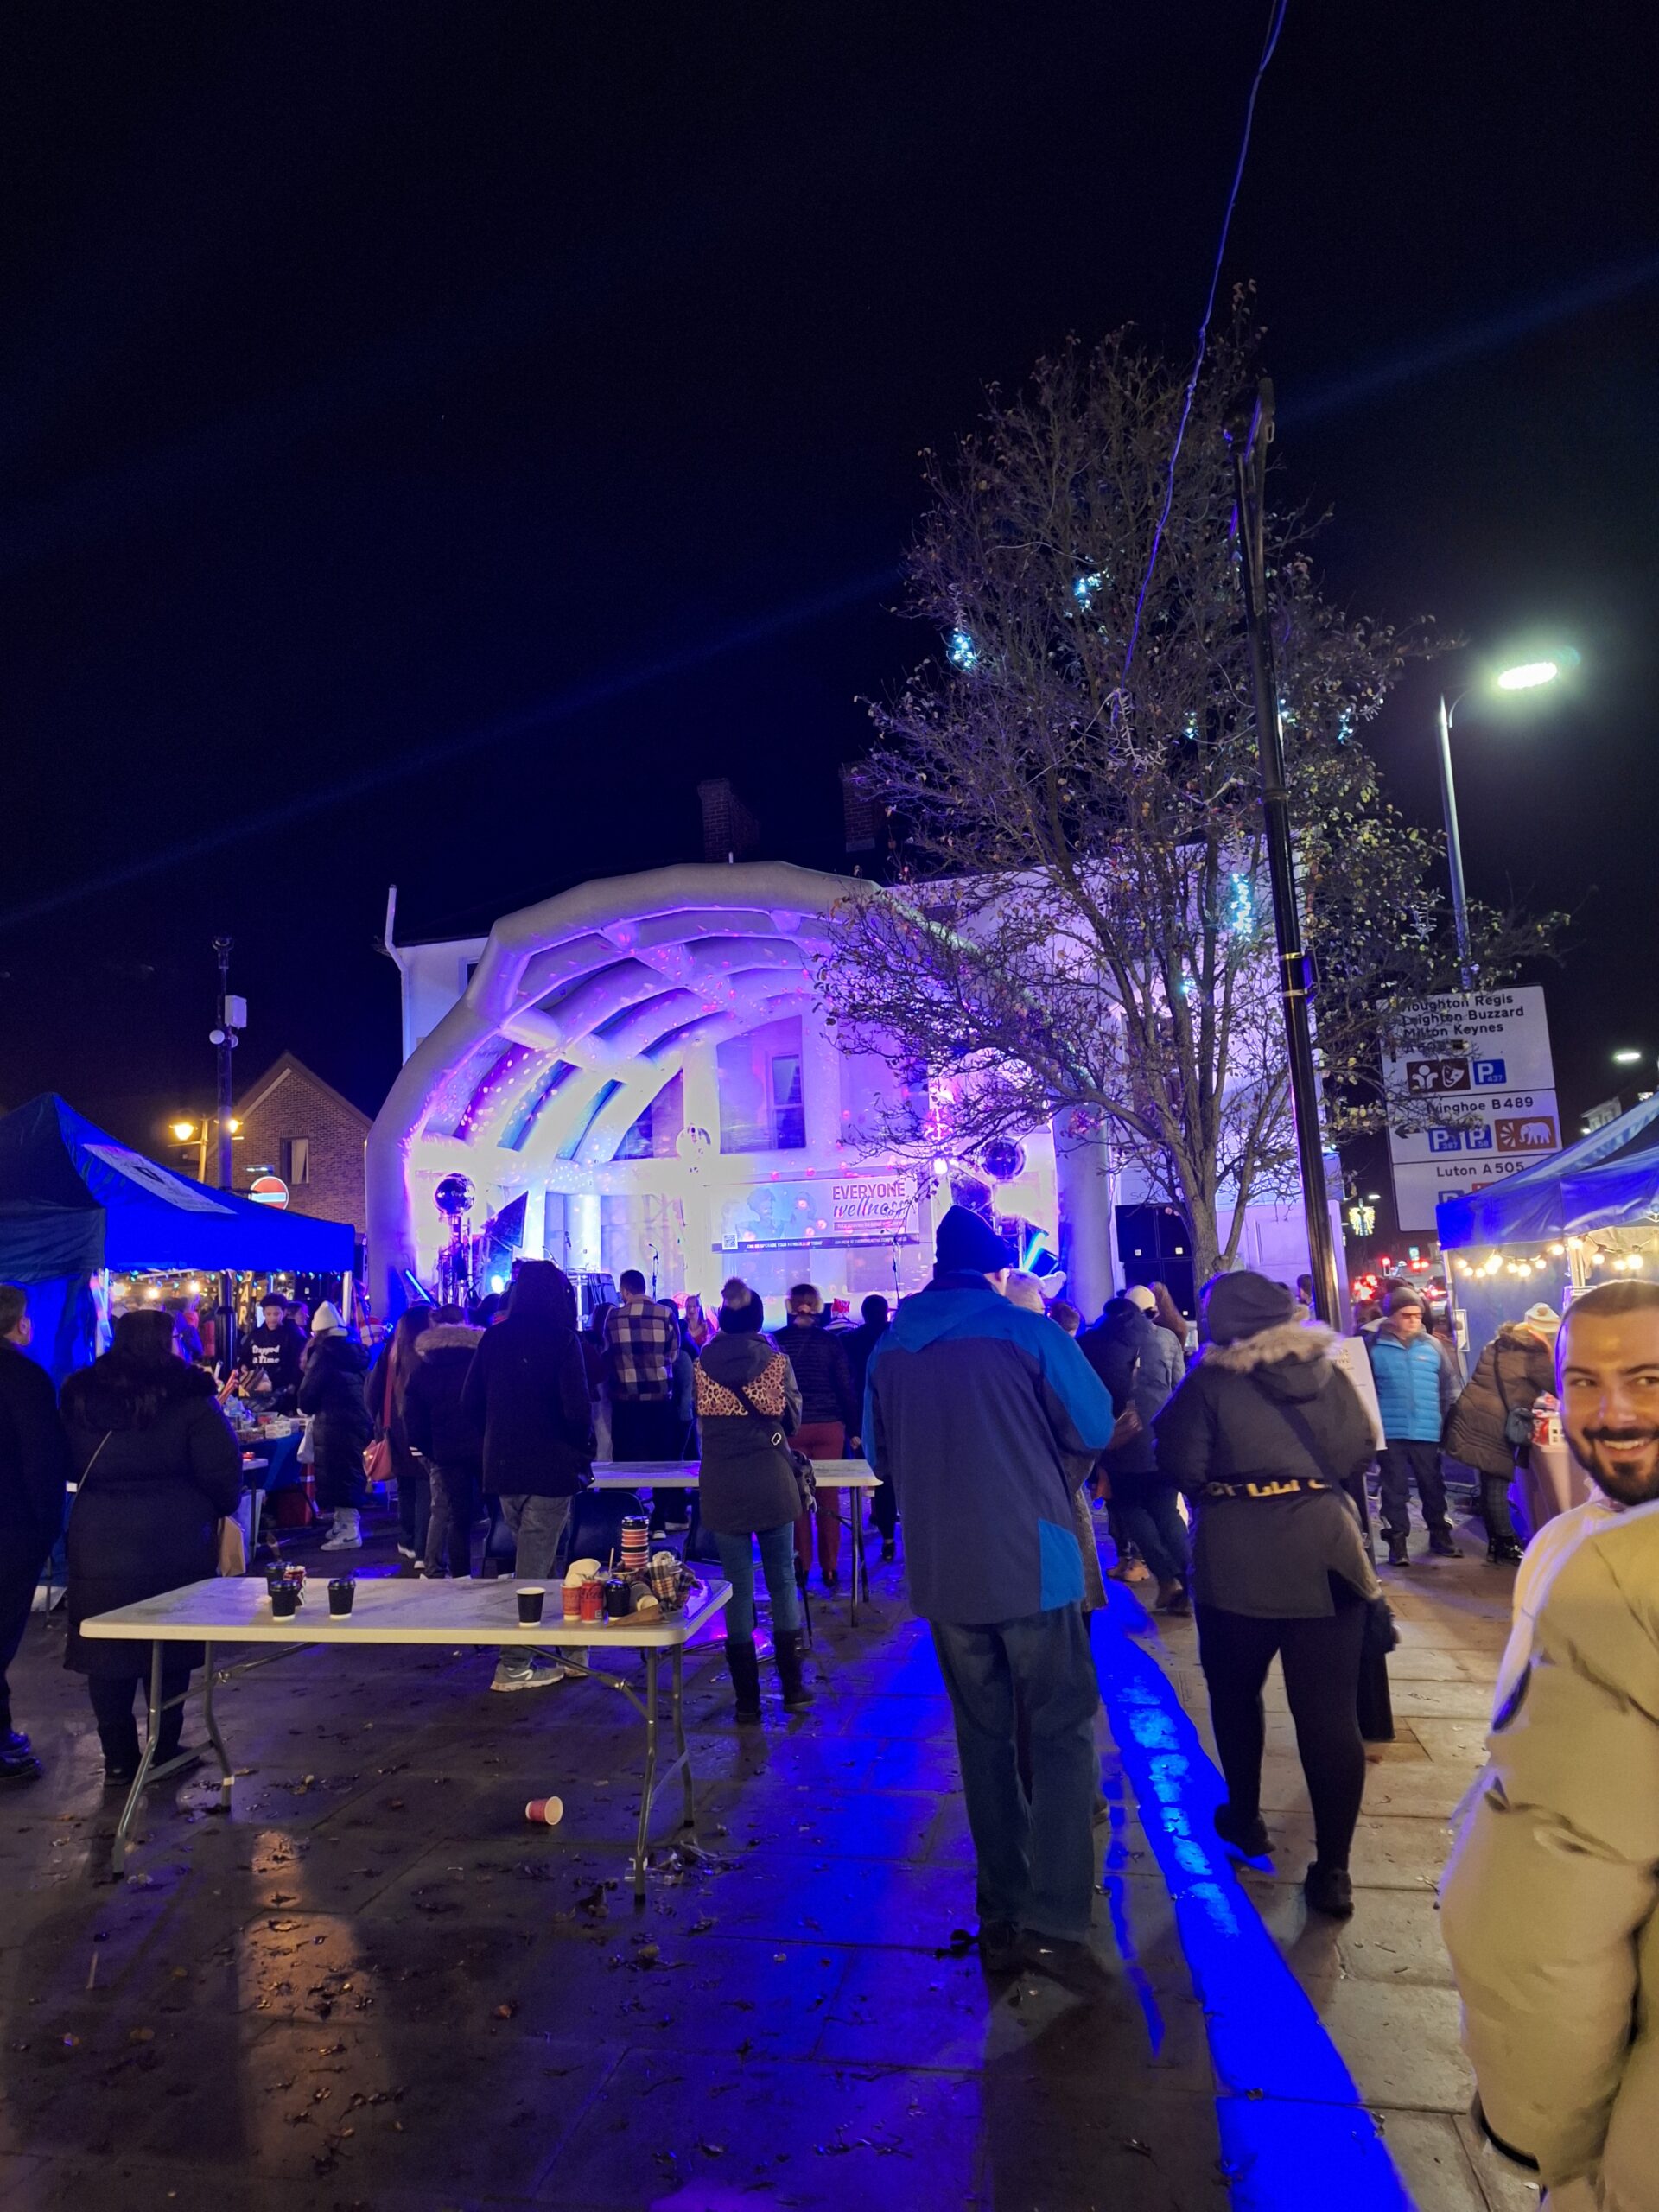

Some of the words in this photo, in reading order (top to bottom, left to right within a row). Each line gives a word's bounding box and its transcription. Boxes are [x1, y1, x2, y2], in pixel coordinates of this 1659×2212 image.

[1475, 994, 1514, 1007] Regis
[1468, 1006, 1524, 1020] Buzzard
[1454, 1023, 1504, 1036] Keynes
[1491, 1096, 1534, 1110] B489
[1436, 1165, 1478, 1178] Luton
[832, 1182, 906, 1201] EVERYONE
